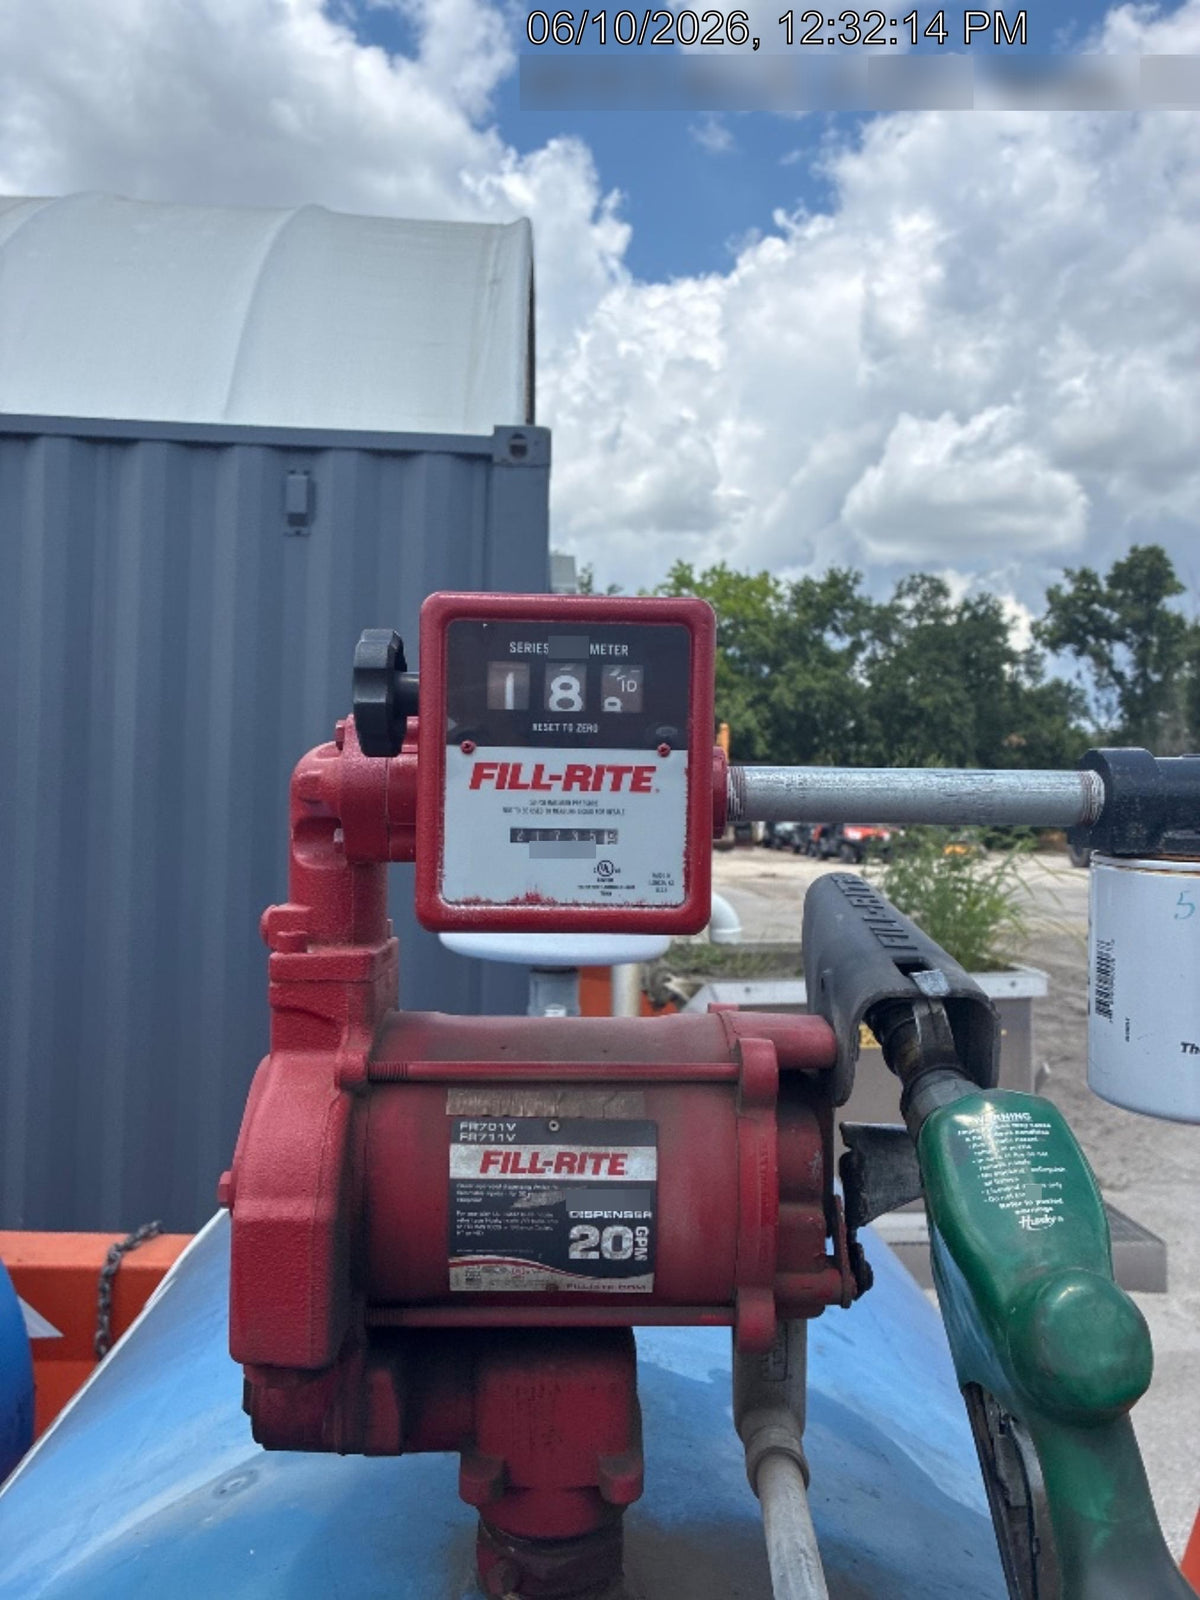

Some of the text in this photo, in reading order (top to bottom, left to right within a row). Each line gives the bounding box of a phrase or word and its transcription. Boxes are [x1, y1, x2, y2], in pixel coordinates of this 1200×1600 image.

[509, 641, 629, 656] SERIES METER
[532, 722, 599, 733] RESET TO ZERO
[468, 762, 657, 793] FILL-RITE
[1173, 890, 1196, 921] 5
[1180, 1041, 1200, 1055] Th
[479, 1150, 629, 1176] FILL-RITE
[569, 1210, 653, 1220] DISPENSER
[568, 1224, 635, 1260] 20
